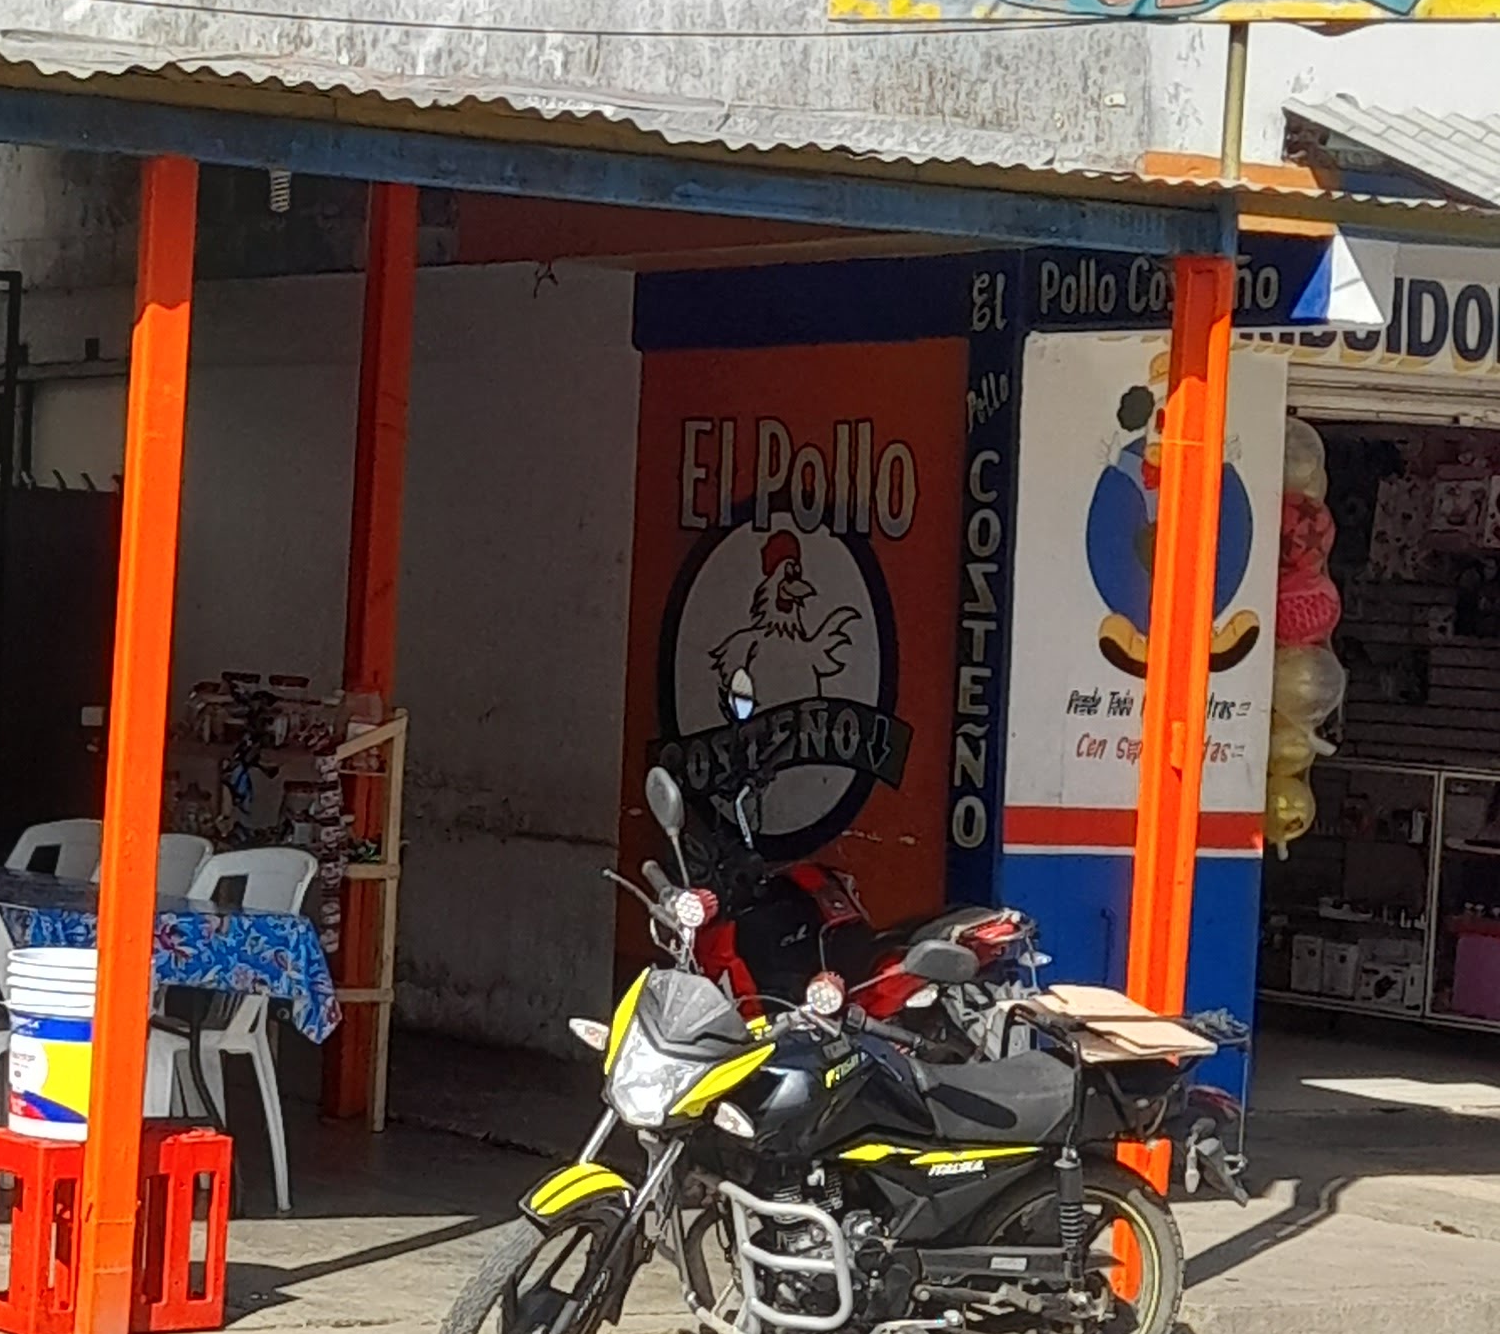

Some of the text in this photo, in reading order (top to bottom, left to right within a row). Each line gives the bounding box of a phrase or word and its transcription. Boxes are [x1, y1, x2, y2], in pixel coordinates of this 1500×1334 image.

[1037, 254, 1281, 317] Pollo Coño
[678, 416, 921, 539] El Pollo
[951, 449, 1002, 851] COSTEÑO
